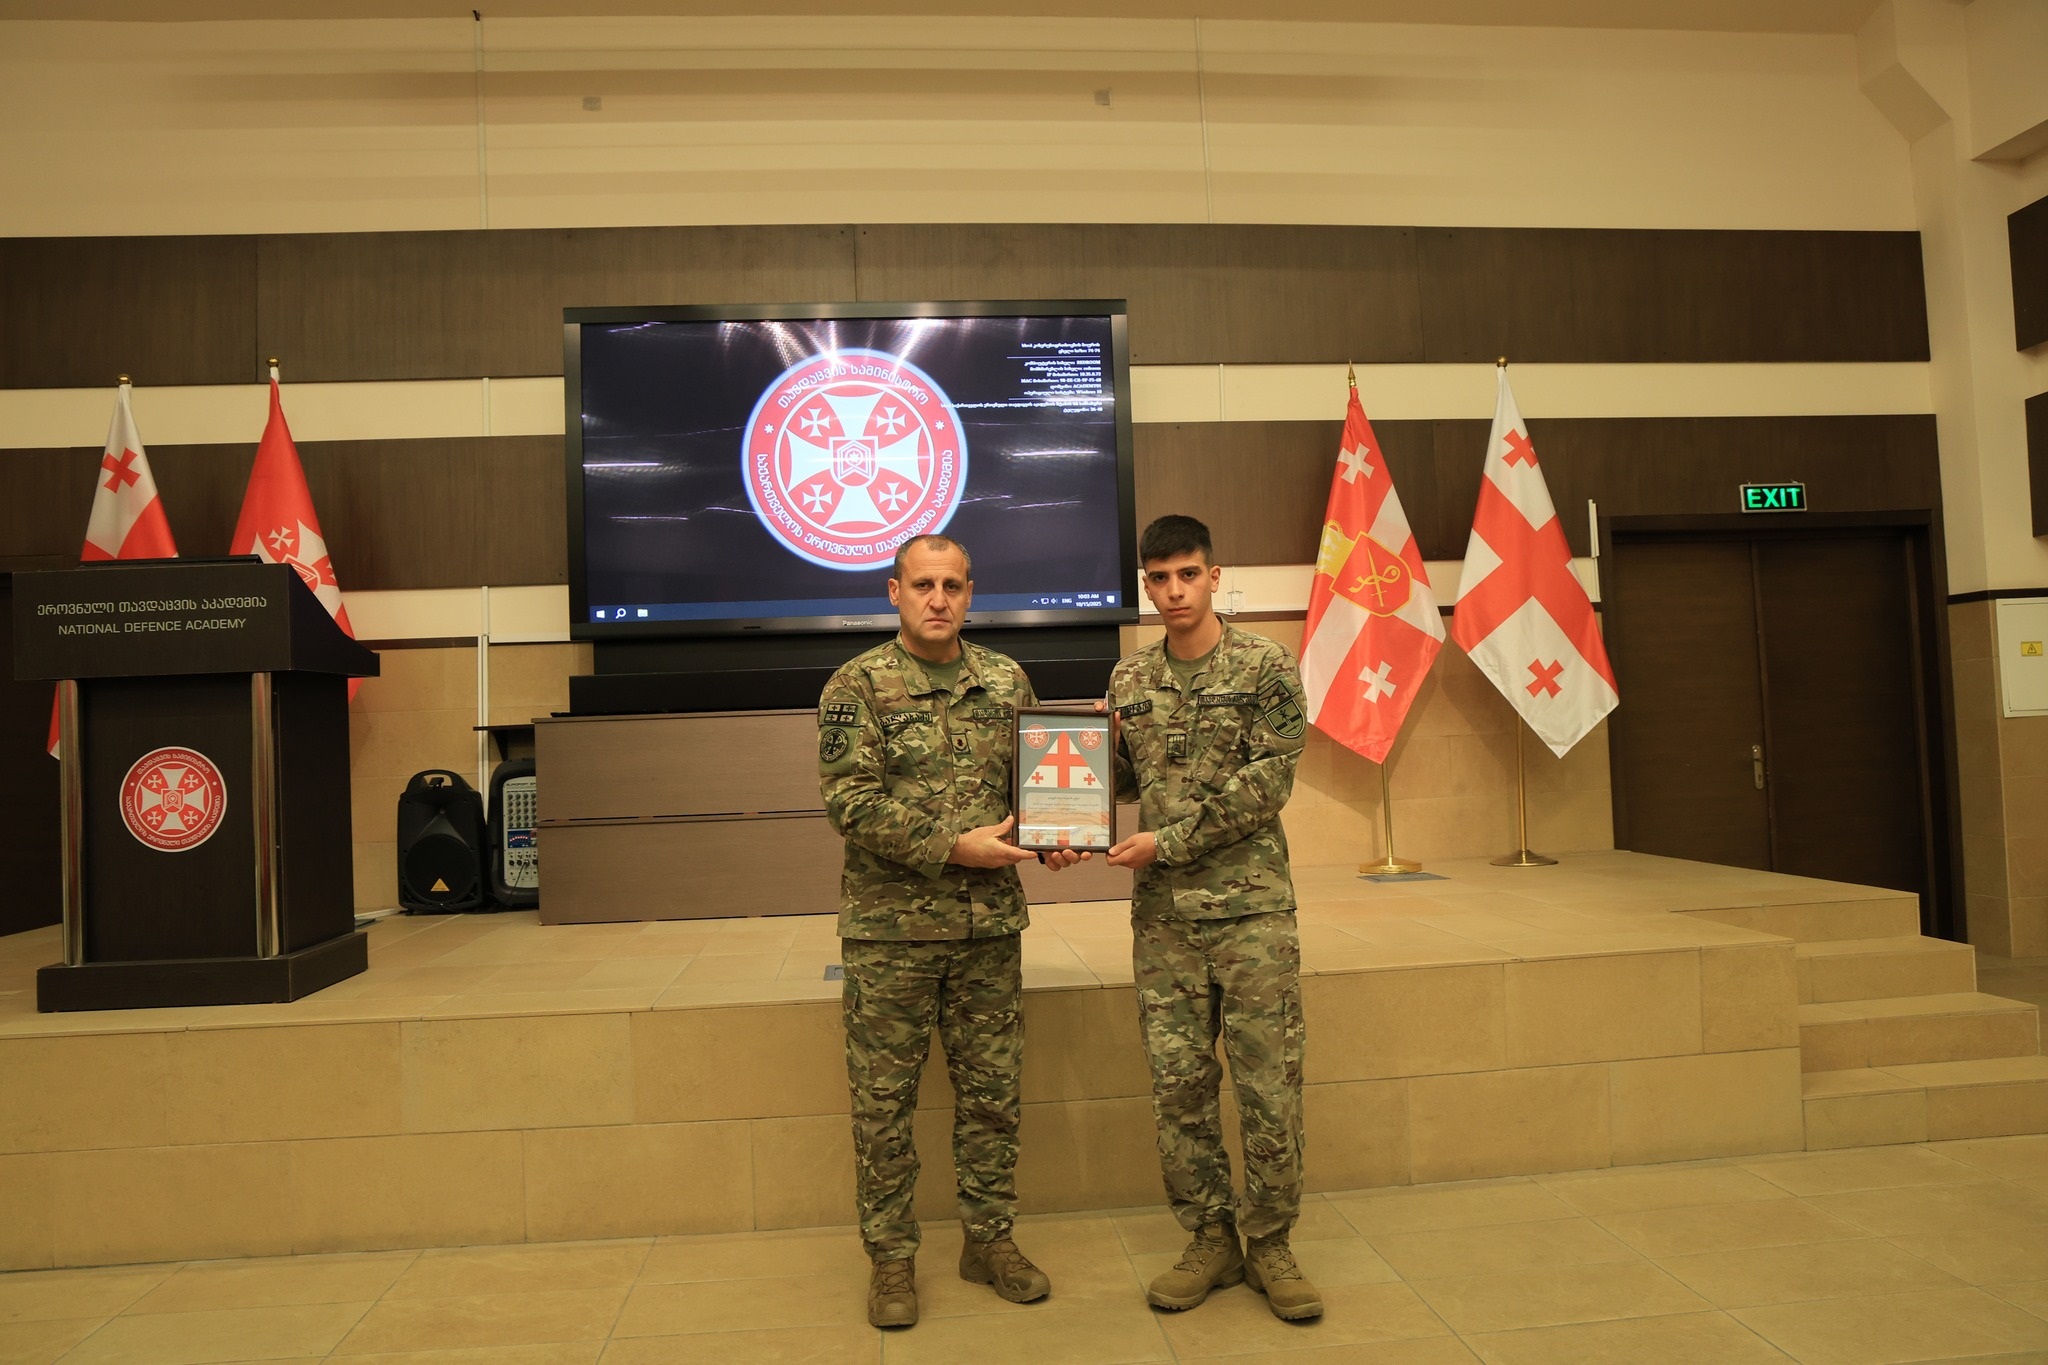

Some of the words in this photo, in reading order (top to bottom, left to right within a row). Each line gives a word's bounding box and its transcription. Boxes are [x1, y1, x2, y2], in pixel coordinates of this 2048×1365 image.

[777, 364, 848, 408] თავდაცვის
[850, 364, 929, 406] სამინისტრო
[756, 453, 804, 538] საქართველოს
[803, 532, 874, 557] ეროვნული
[876, 509, 937, 553] თავდაცვის
[934, 449, 954, 508] აკადემია
[1746, 487, 1801, 508] EXIT
[37, 602, 115, 616] ეროვნული
[118, 599, 197, 613] თავდაცვის
[201, 596, 267, 610] აკადემია
[58, 623, 121, 635] NATIONAL
[124, 620, 182, 633] DEFENCE
[185, 618, 247, 631] ACADEMY
